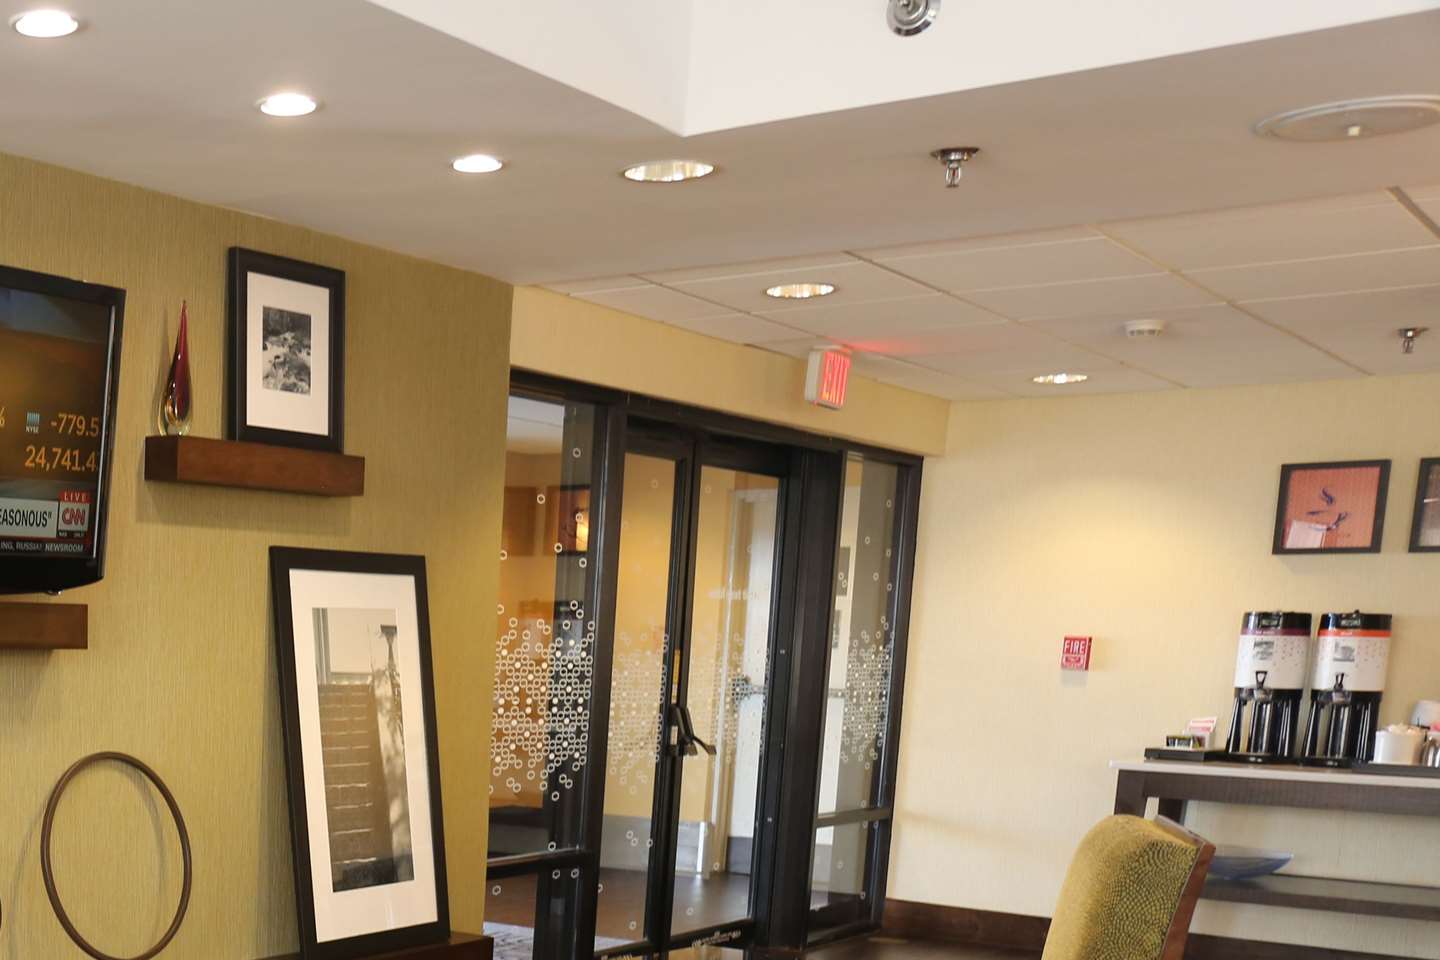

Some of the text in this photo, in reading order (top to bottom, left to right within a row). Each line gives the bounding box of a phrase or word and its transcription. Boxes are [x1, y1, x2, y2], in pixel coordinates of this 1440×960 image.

[64, 491, 86, 501] LIVE
[62, 507, 86, 526] CNN
[1064, 640, 1086, 654] FIRE
